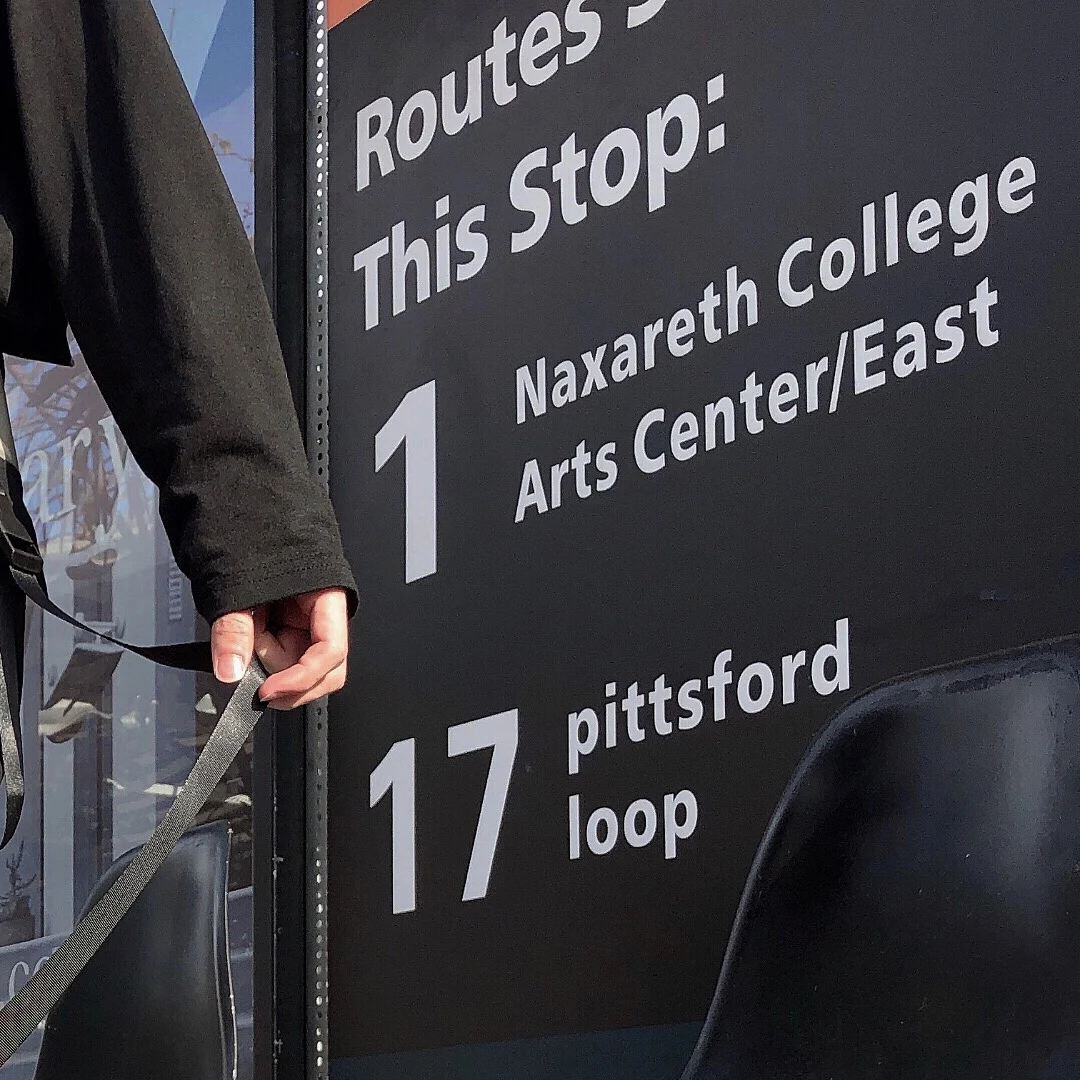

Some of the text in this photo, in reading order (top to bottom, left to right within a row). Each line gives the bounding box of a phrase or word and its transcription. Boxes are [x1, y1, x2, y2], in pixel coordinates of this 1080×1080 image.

[356, 0, 602, 191] Routes
[354, 73, 726, 331] This Stop:
[515, 155, 1037, 425] Naxareth College
[374, 380, 437, 585] 1
[515, 277, 1000, 524] Arts Center/East
[568, 617, 851, 775] pittsford
[369, 708, 520, 915] 17
[568, 789, 699, 859] loop
